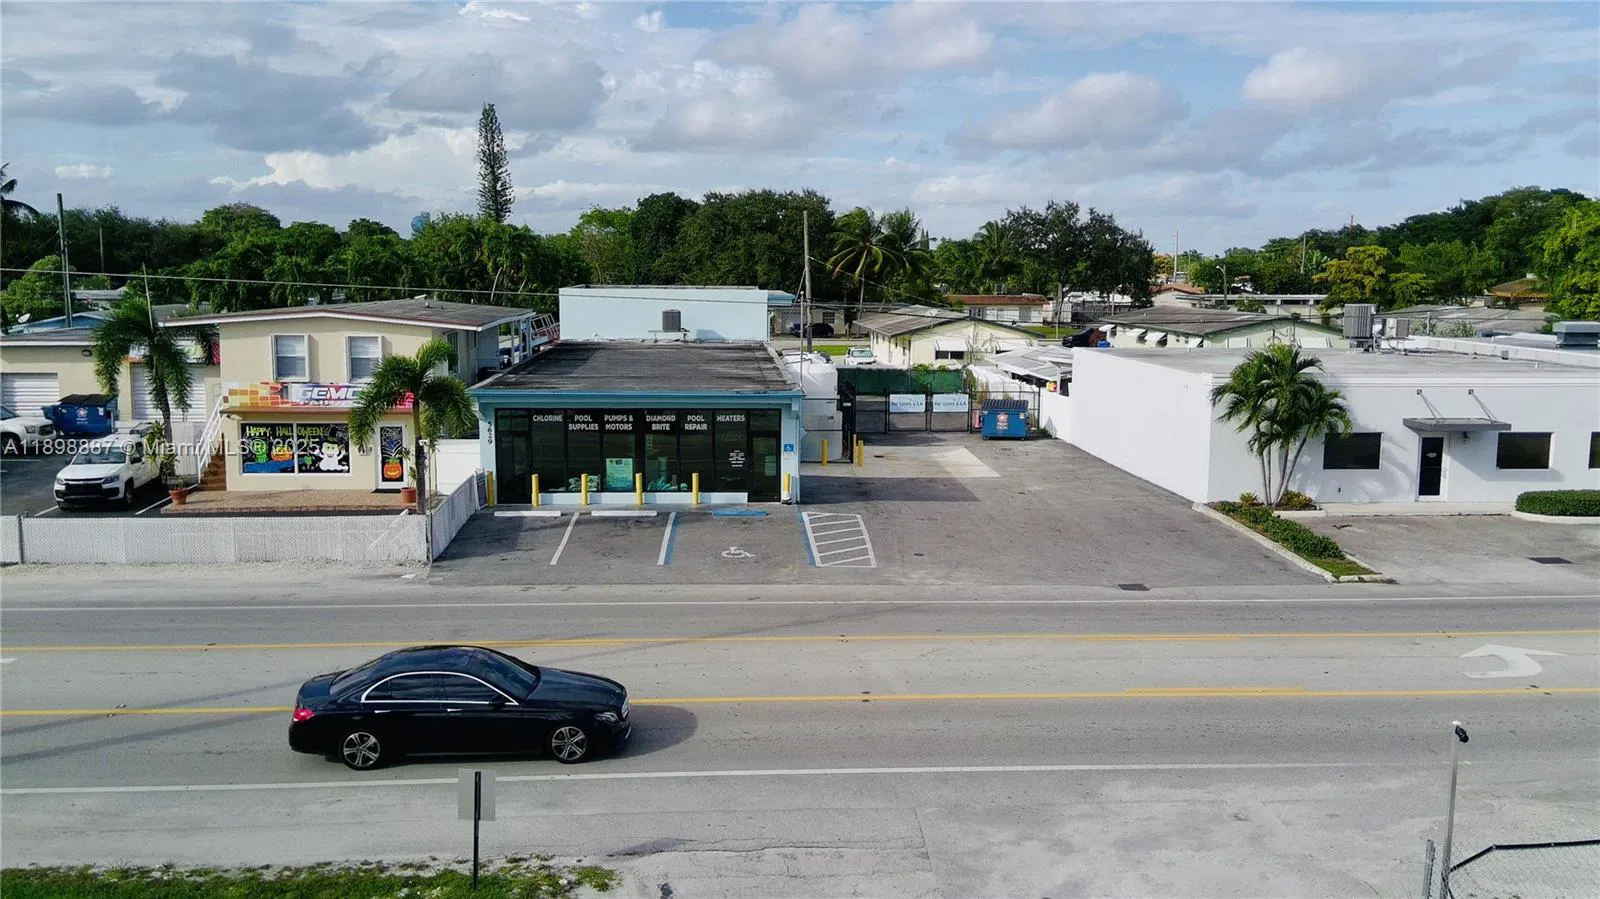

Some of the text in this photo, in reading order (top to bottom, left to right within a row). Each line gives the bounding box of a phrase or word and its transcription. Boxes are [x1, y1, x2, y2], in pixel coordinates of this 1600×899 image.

[532, 414, 563, 422] CHLORINE
[574, 414, 593, 422] POOL
[604, 414, 634, 422] PUMPS &
[646, 414, 676, 422] DIAMOND
[687, 414, 705, 422] POOL
[716, 414, 746, 422] HEATERS
[568, 423, 599, 431] SUPPLIES
[605, 423, 633, 431] MOTORS
[651, 423, 671, 431] BRITE
[684, 423, 708, 431] REPAIR
